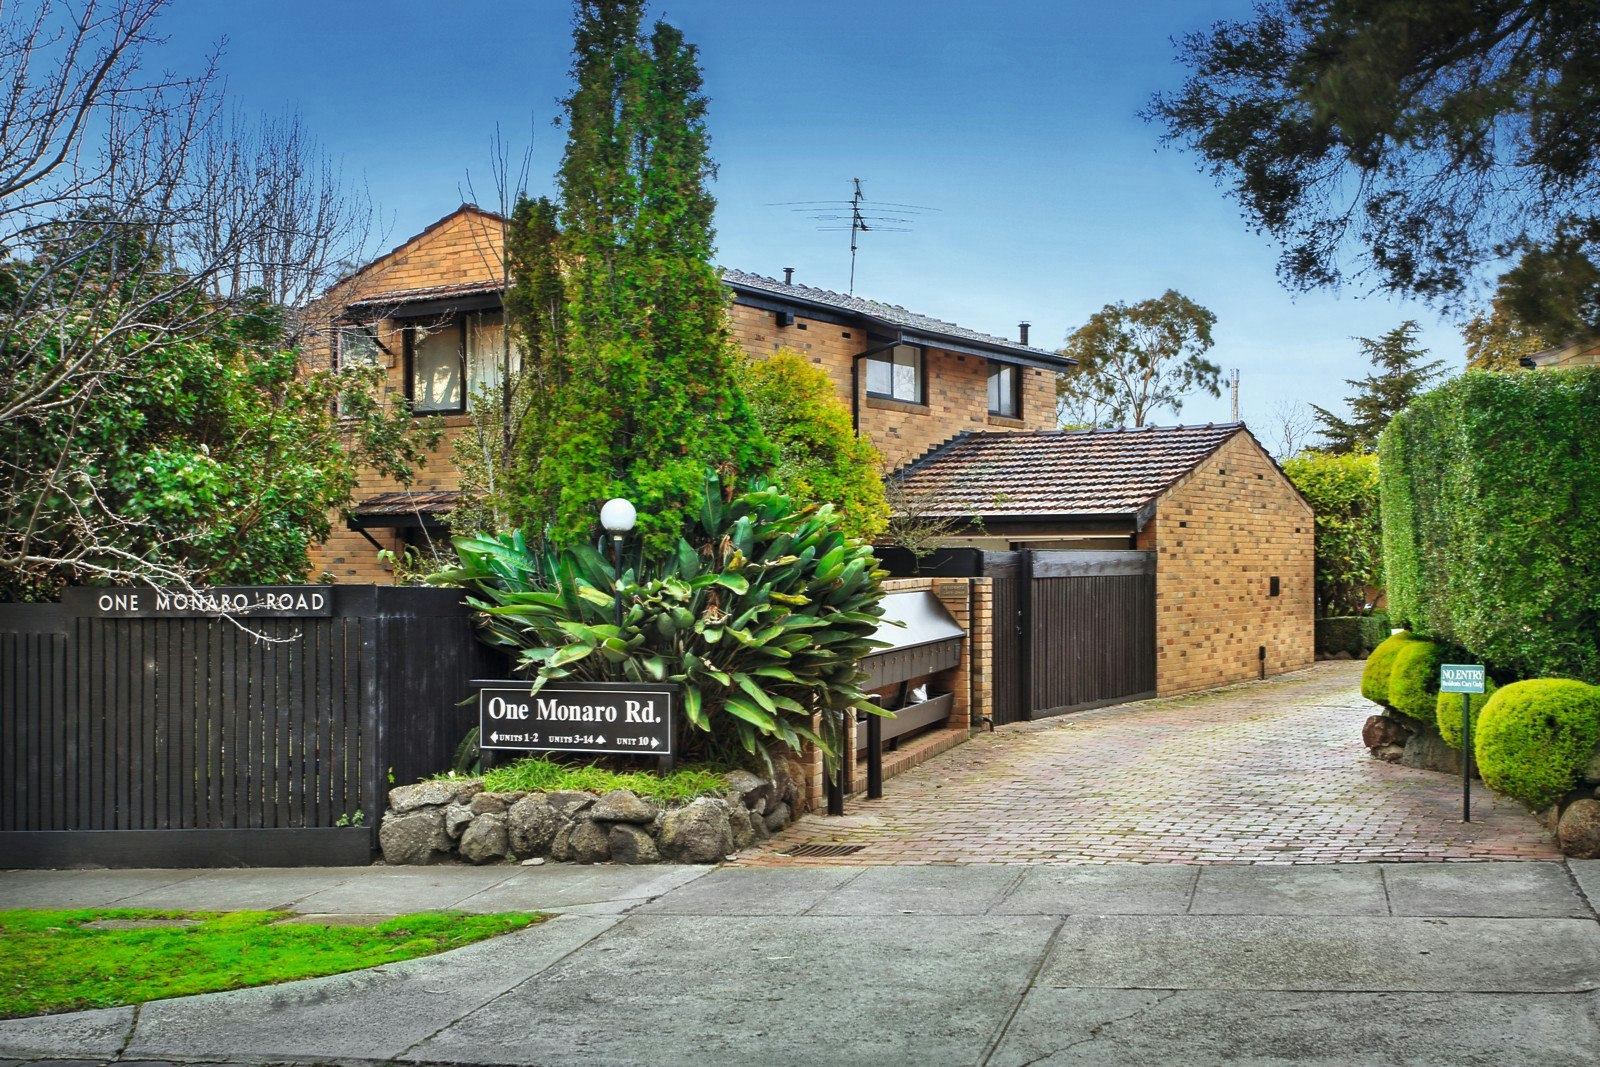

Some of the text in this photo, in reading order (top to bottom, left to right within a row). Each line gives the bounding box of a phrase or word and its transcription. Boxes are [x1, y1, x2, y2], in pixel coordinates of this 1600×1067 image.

[98, 593, 325, 612] ONE MONARO ROAD
[1442, 670, 1483, 680] NO ENTRY
[488, 697, 661, 724] One Monaro Rd.
[499, 733, 539, 743] UNITS 1-2
[549, 735, 594, 745] UNITS 3-14
[616, 737, 649, 746] UNIT 10
